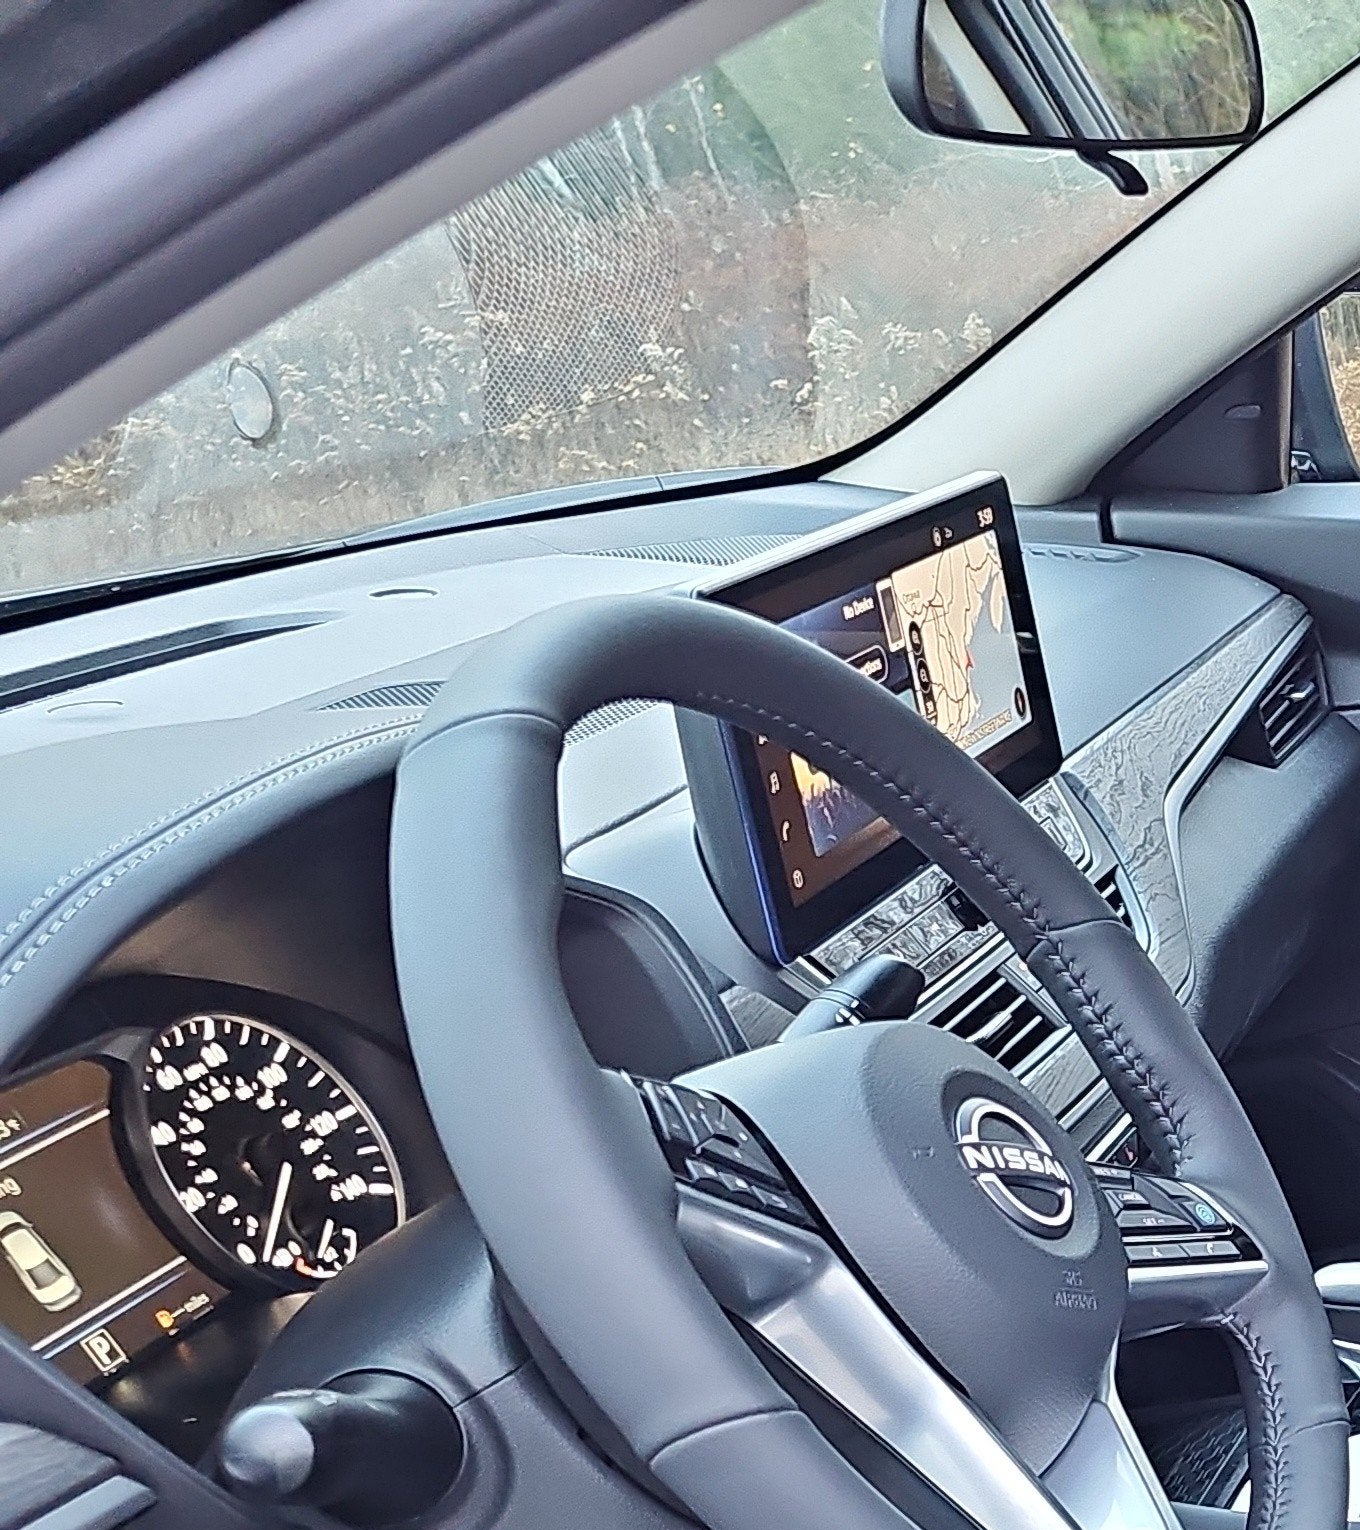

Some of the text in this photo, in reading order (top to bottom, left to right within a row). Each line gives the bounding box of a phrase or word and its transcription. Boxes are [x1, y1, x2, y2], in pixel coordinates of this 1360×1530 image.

[200, 1042, 229, 1067] 80
[156, 1065, 183, 1090] 60
[257, 1063, 288, 1089] 100
[310, 1110, 339, 1137] 120
[961, 1145, 1072, 1187] NISSAN
[236, 1242, 257, 1264] 0
[89, 1336, 112, 1365] P
